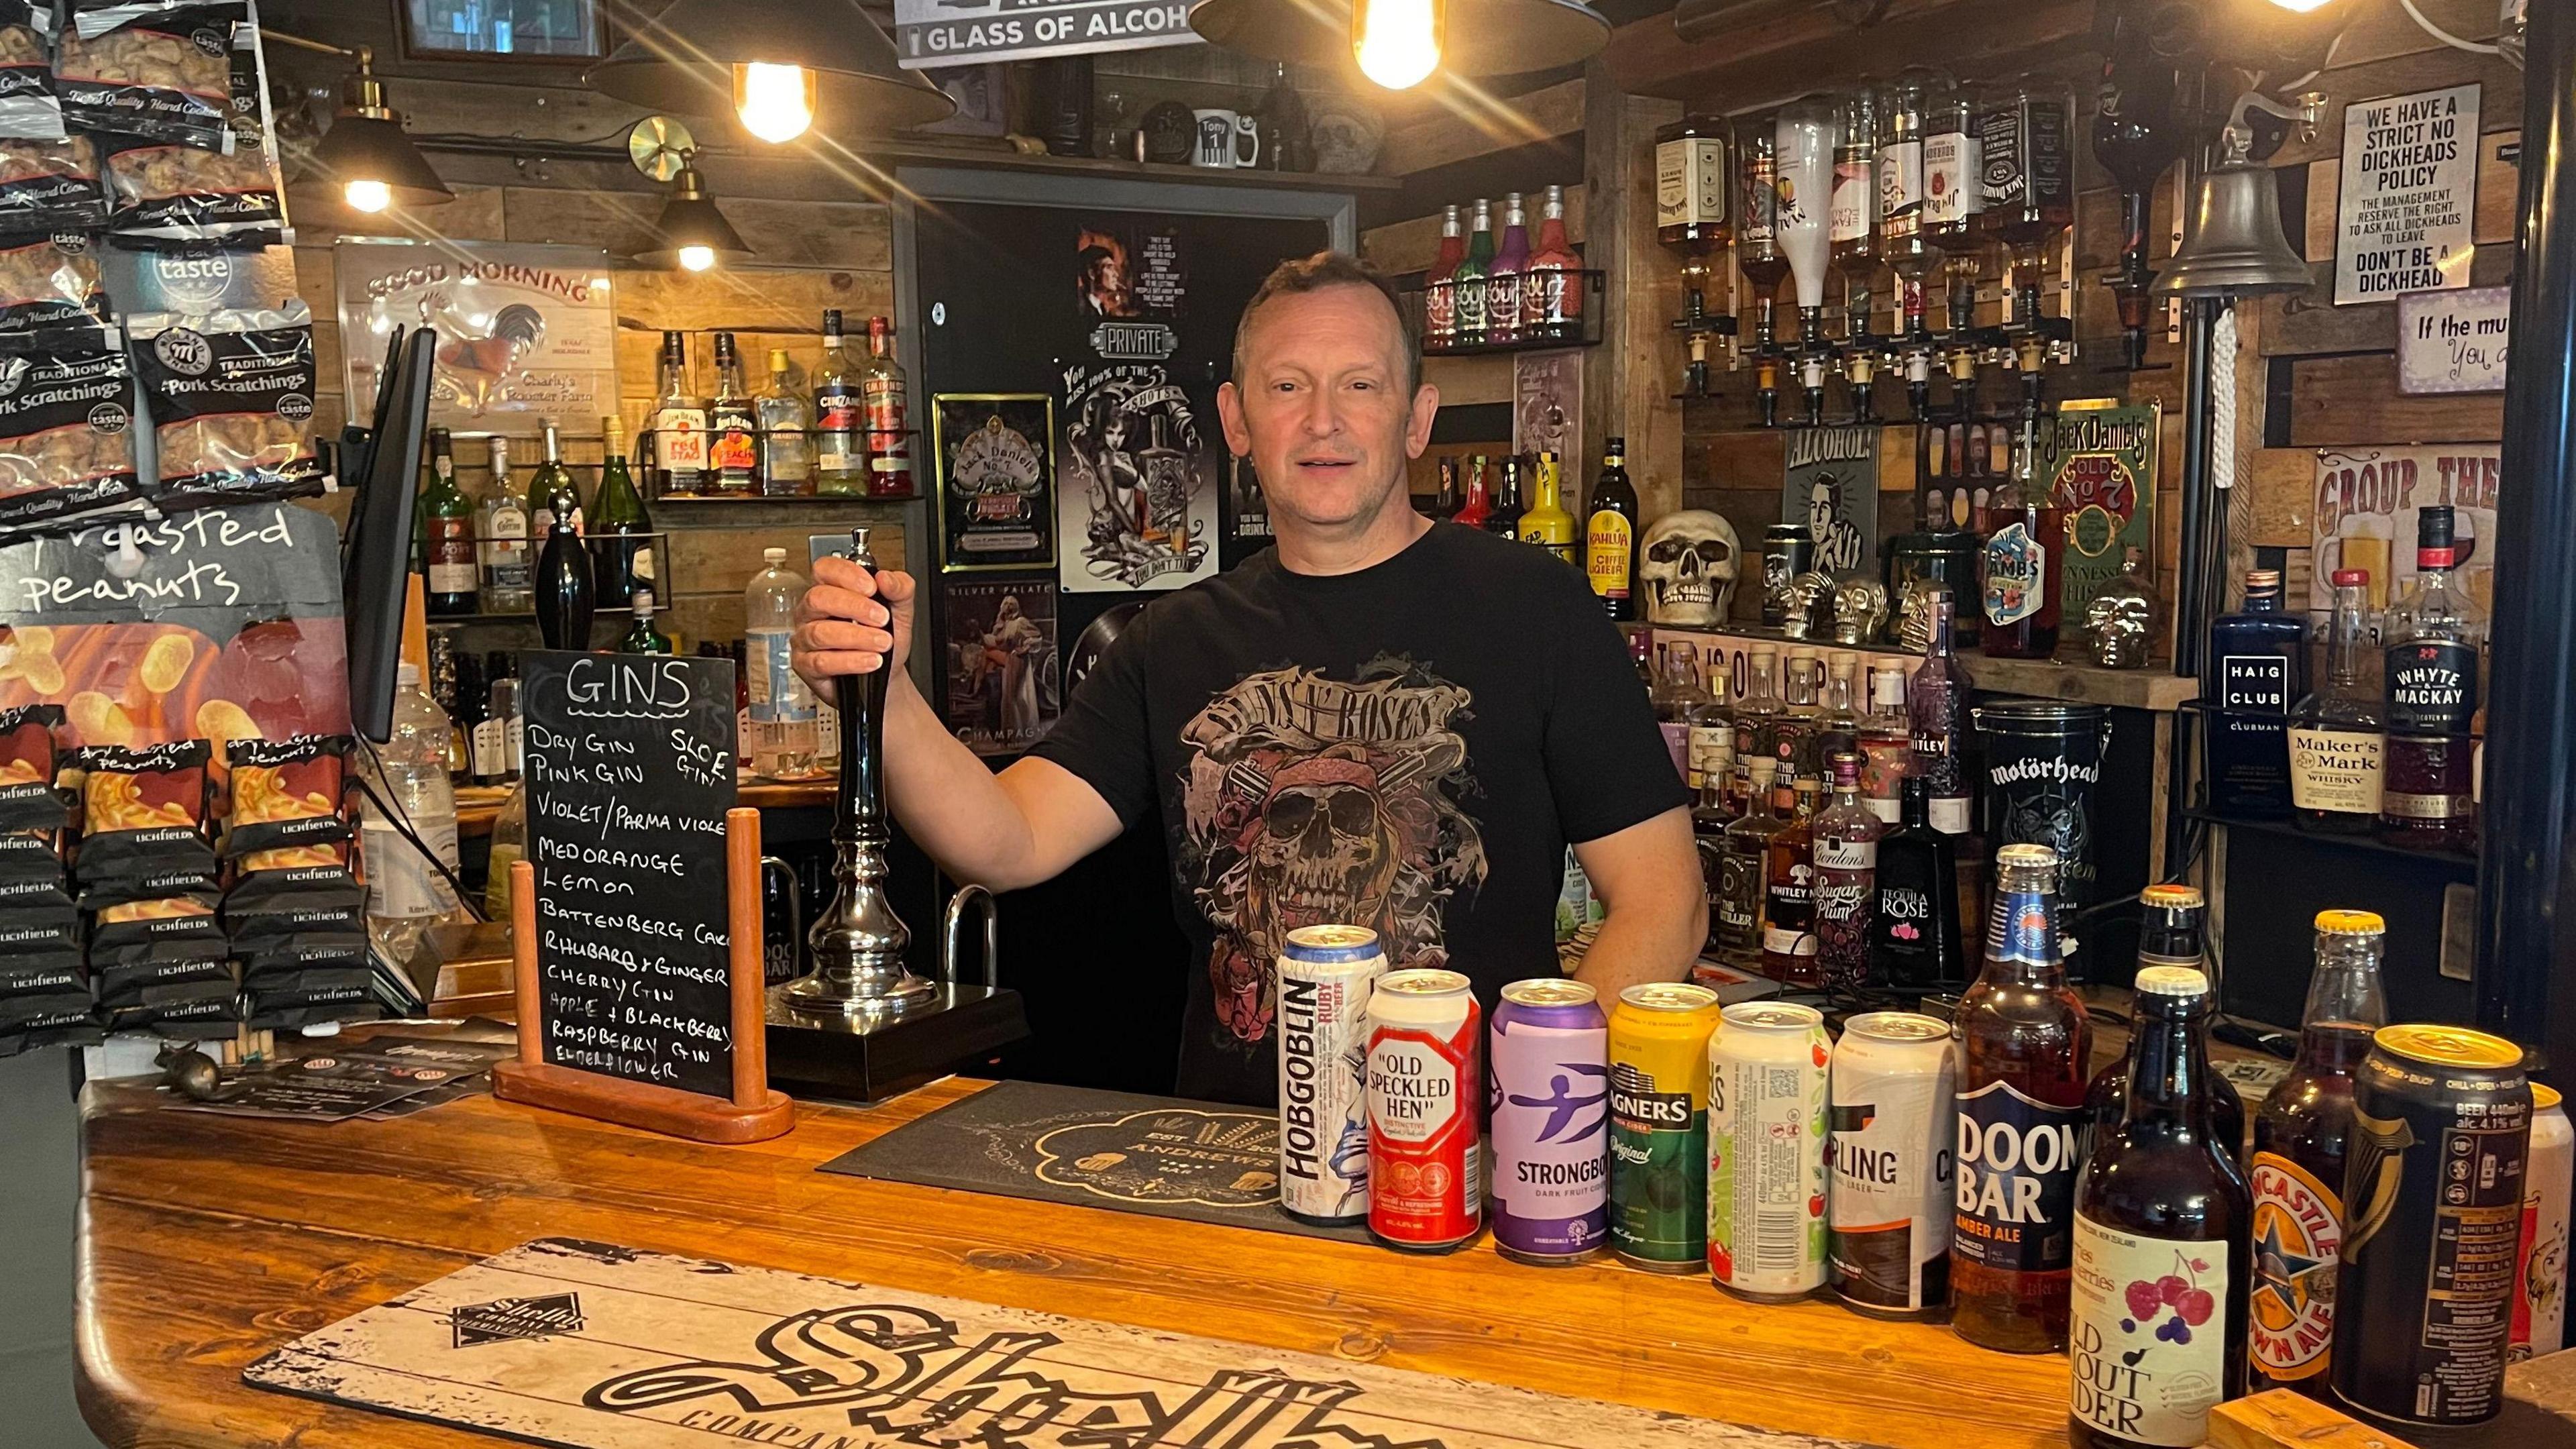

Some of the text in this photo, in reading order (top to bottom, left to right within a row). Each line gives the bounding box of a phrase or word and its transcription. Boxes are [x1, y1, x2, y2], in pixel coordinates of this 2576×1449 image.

[927, 5, 1187, 51] GLASS OF ALCOH
[151, 99, 181, 113] Hand
[2367, 97, 2457, 128] WE HAVE A
[1203, 121, 1226, 134] Tony
[2367, 118, 2455, 151] STRICT NO
[1210, 133, 1218, 148] 1
[2361, 141, 2457, 173] DICKHEADS
[2378, 165, 2438, 192] POLICY
[2358, 201, 2455, 223] RESERVE THE RIGHT
[2363, 189, 2452, 210] THE MANAGEMENT
[2349, 213, 2461, 236] TO ASK ALL DICKHEADS
[55, 235, 87, 247] taste
[2381, 229, 2426, 246] TO LEAVE
[159, 258, 228, 279] taste
[2357, 248, 2406, 272] DON'T
[2412, 246, 2432, 266] BE
[460, 262, 590, 303] MORNING
[2359, 268, 2443, 293] DICKHEAD
[2418, 315, 2470, 339] If the
[1108, 328, 1162, 354] PRIVATE
[1116, 366, 1127, 377] OF
[1130, 365, 1149, 377] THE
[2448, 338, 2492, 380] You
[168, 371, 307, 396] Pork Scratchings
[1063, 366, 1085, 394] YOU
[20, 381, 122, 411] Scratchings
[1132, 388, 1172, 410] SHOTS
[93, 413, 124, 426] taste
[280, 404, 312, 416] taste
[670, 438, 699, 452] red
[1789, 425, 1872, 470] ALCOHOL!
[2047, 415, 2147, 468] Jack Daniel's
[961, 451, 986, 475] Jack
[2076, 460, 2110, 475] OLD
[26, 490, 98, 517] Quality Hand
[2101, 479, 2126, 509] 7
[2318, 456, 2501, 537] GROUP THE
[18, 559, 241, 613] peanuts
[1003, 584, 1051, 596] PALATE
[567, 658, 690, 709] GINS
[2231, 665, 2280, 678] HAIG
[2396, 667, 2461, 688] WHYTE
[2230, 692, 2281, 704] CLUB
[2395, 689, 2463, 705] MACKAY
[1336, 691, 1439, 742] ROSES
[2231, 722, 2280, 731] CLUBMAN
[528, 724, 635, 761] DRY GIN
[670, 729, 730, 781] SLOE
[2296, 736, 2379, 754] Maker's
[527, 753, 644, 786] PINK GIN
[676, 756, 716, 788] GIN
[1990, 755, 2100, 786] motörhead
[2318, 755, 2377, 771] Mark
[2306, 773, 2366, 785] WHISKY
[678, 817, 725, 837] VIOLE
[1813, 846, 1865, 868] Gordon's
[1770, 885, 1807, 899] WHITLEY
[1815, 875, 1866, 907] Sugar
[1882, 889, 1927, 902] TEQUILA
[539, 897, 684, 941] BATTENBERG
[1815, 898, 1861, 921] Plum
[1881, 898, 1929, 918] ROSE
[545, 929, 729, 988] RHUBARB GINGER
[547, 964, 628, 1003] CHERRY
[1317, 981, 1333, 1024] RUBY
[549, 992, 736, 1053] APPLE BLACKBERRY
[552, 1019, 710, 1067] RASPBERRY GIN
[555, 1044, 679, 1081] ELDERFLOWER
[1283, 975, 1320, 1181] HOBGOBLIN
[1369, 1069, 1451, 1099] SPECKLED
[2455, 1102, 2487, 1116] BEER
[1126, 1143, 1275, 1168] ANDREWS
[1611, 1134, 1653, 1165] Original
[1535, 1186, 1589, 1197] DARK FRUIT
[1847, 1179, 1872, 1193] LAGER
[1956, 1161, 2047, 1224] BAR
[1956, 1213, 2021, 1243] AMBER ALE
[2294, 1305, 2334, 1355] ALE
